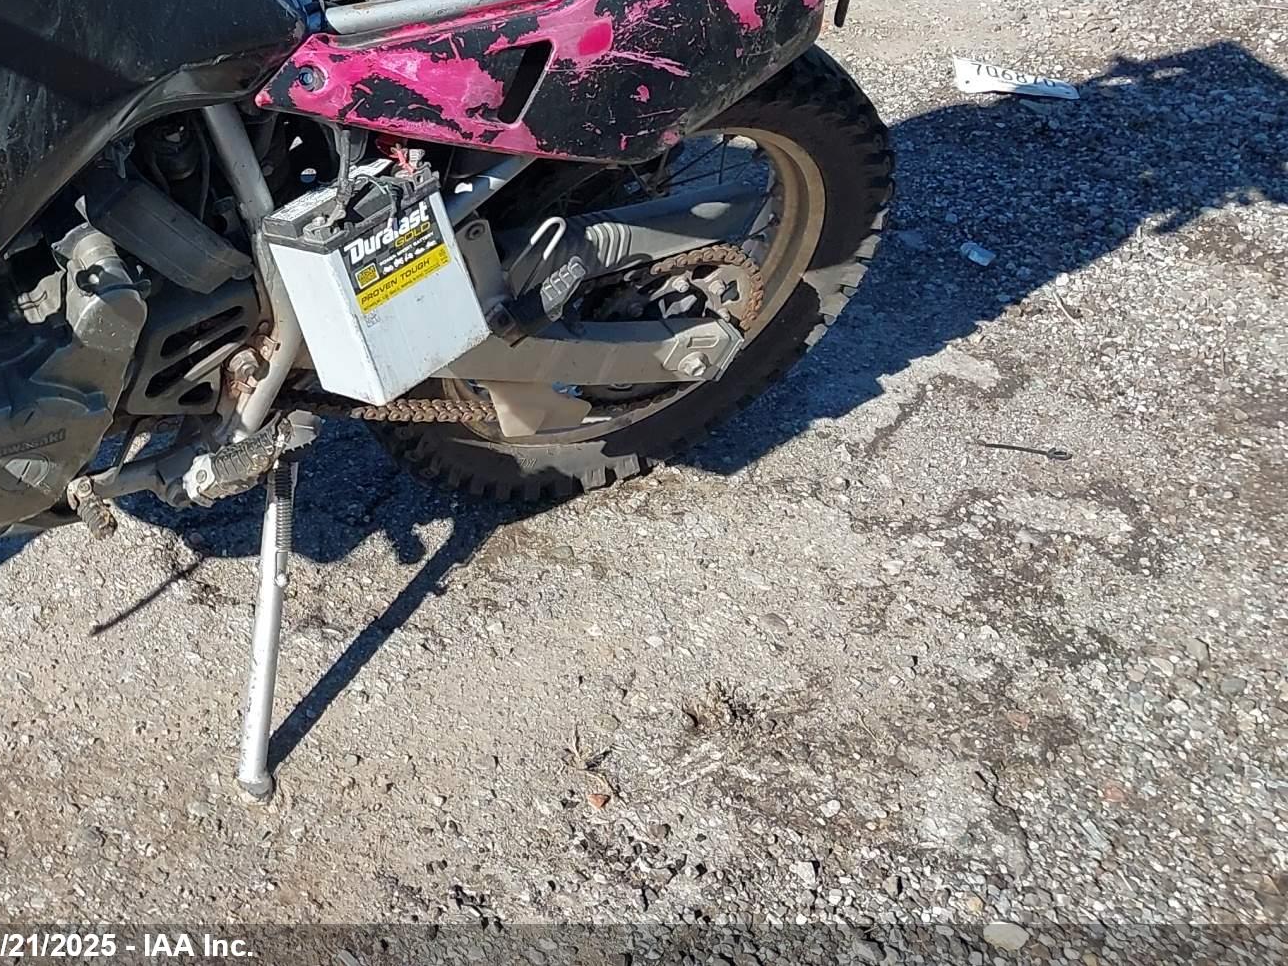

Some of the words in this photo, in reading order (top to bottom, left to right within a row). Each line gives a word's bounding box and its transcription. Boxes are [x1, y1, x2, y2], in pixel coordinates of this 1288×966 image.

[395, 221, 431, 248] GOLD
[361, 278, 398, 305] PROVEN
[399, 257, 431, 281] TOUGH
